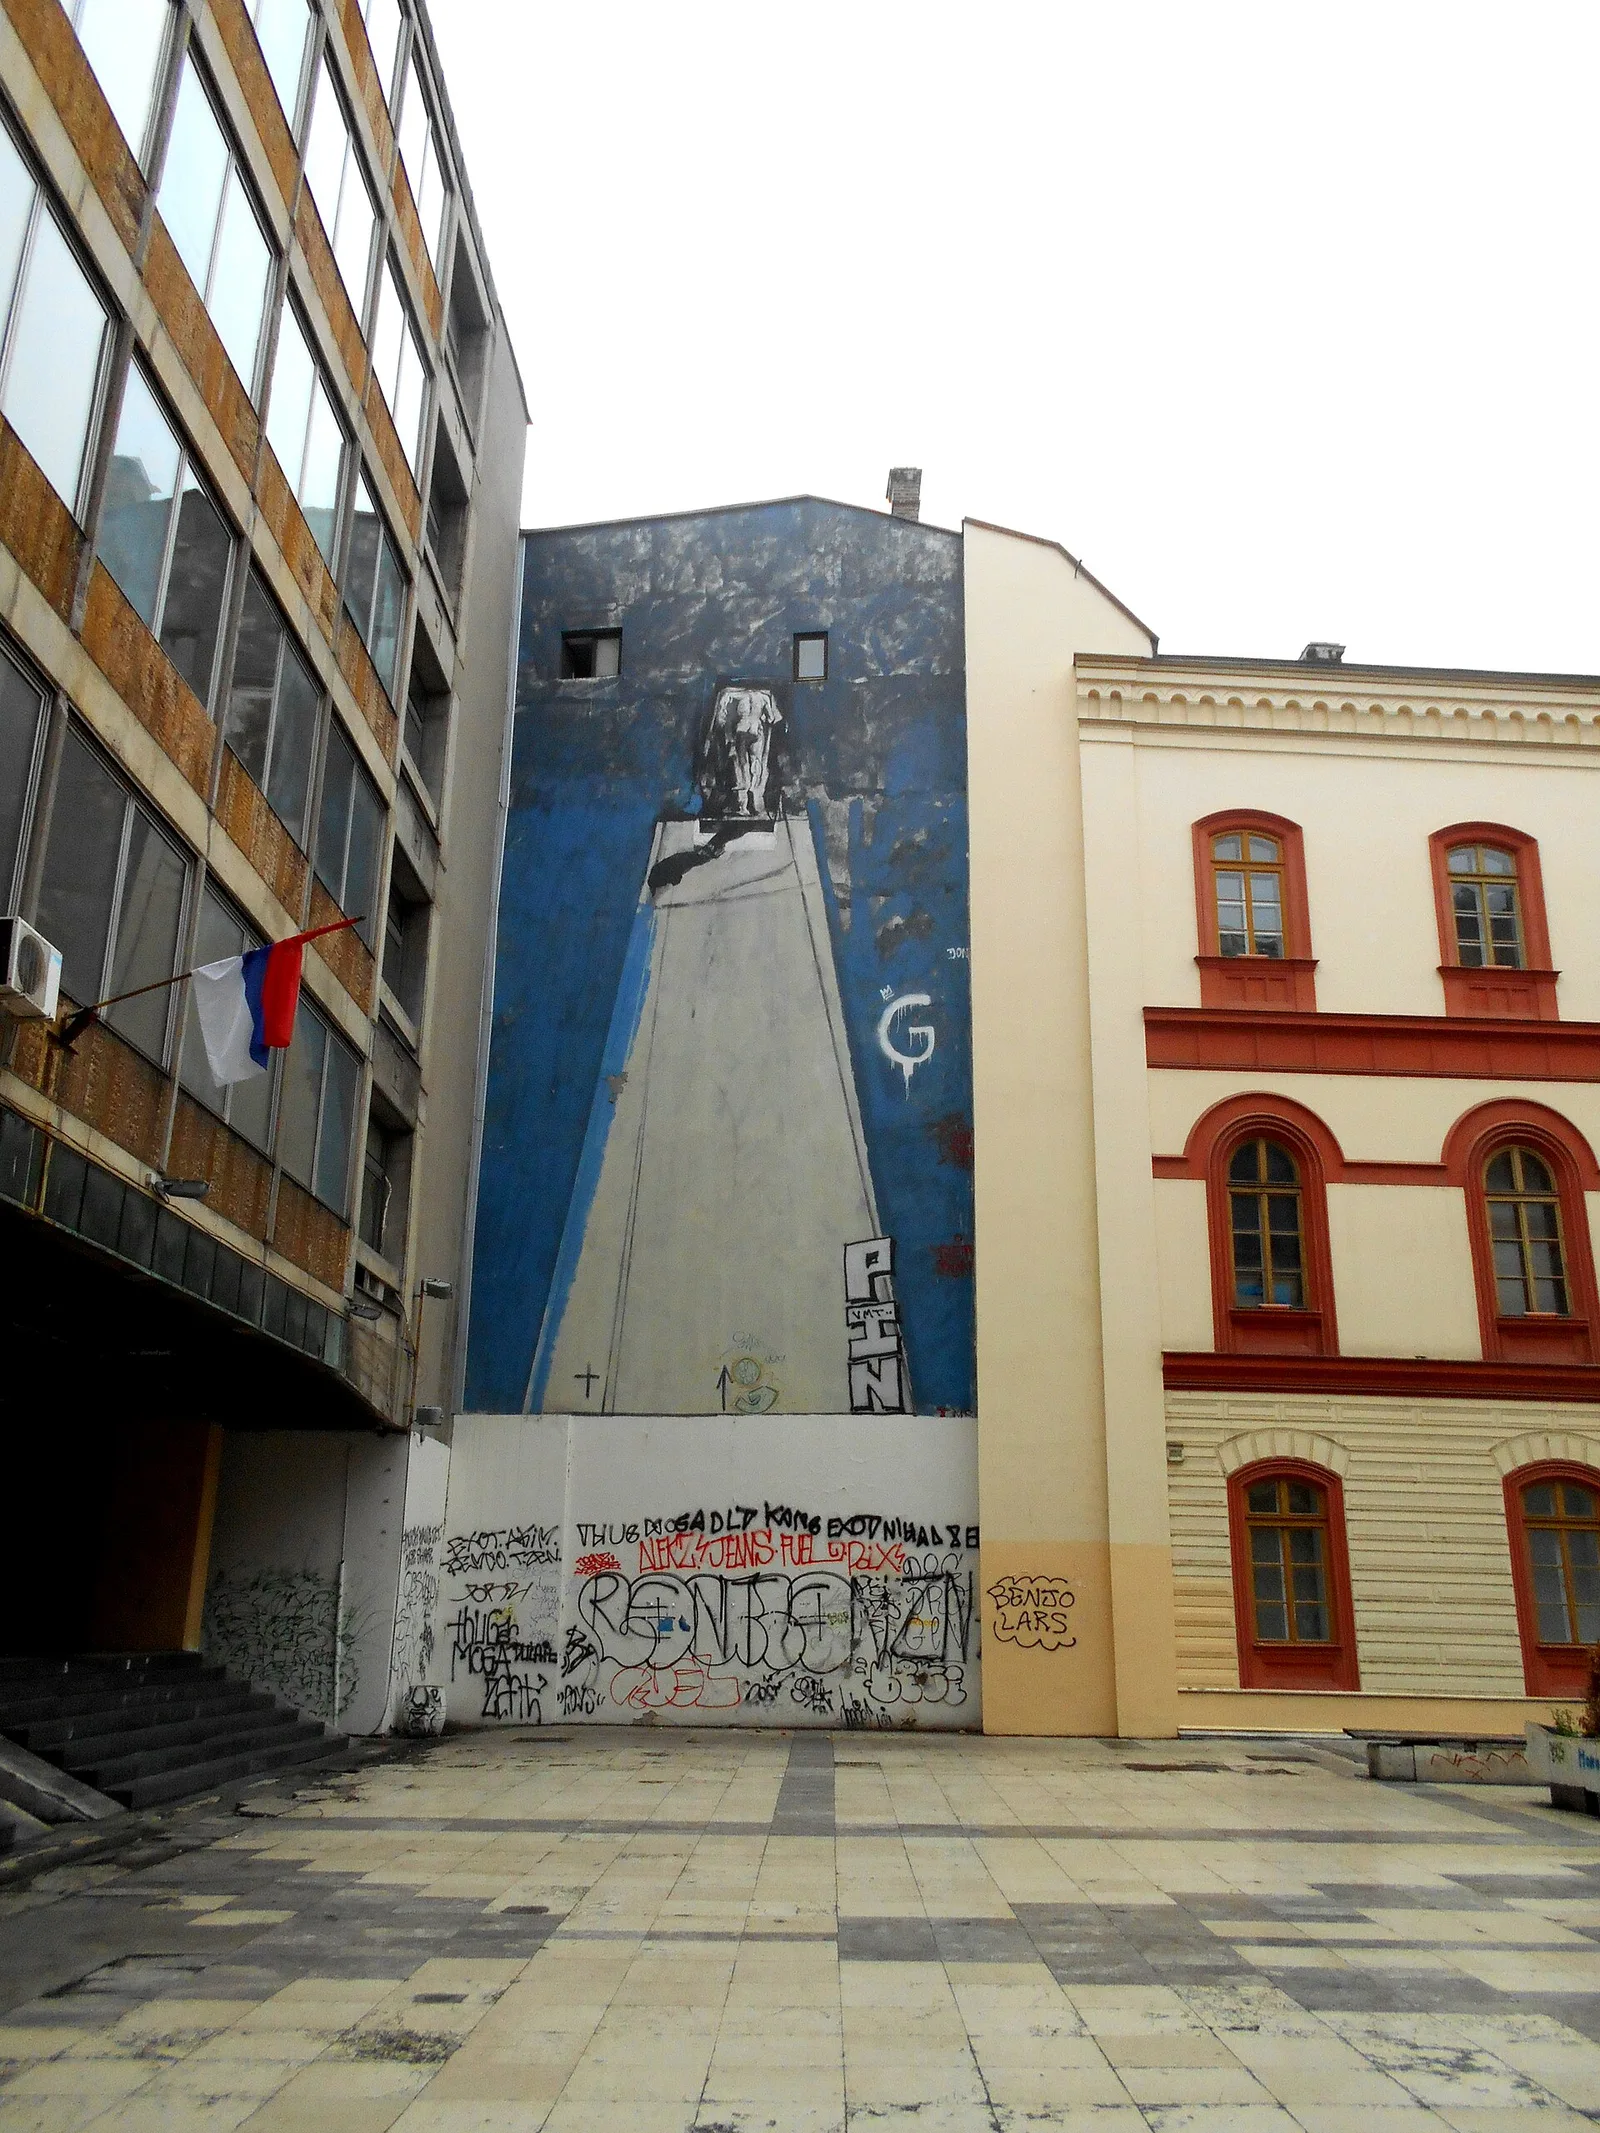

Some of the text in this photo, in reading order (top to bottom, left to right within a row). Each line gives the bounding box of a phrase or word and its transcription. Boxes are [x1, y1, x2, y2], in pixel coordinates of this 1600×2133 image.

[877, 993, 935, 1064] G
[987, 1585, 1075, 1610] BENJO
[1001, 1611, 1068, 1634] LARS
